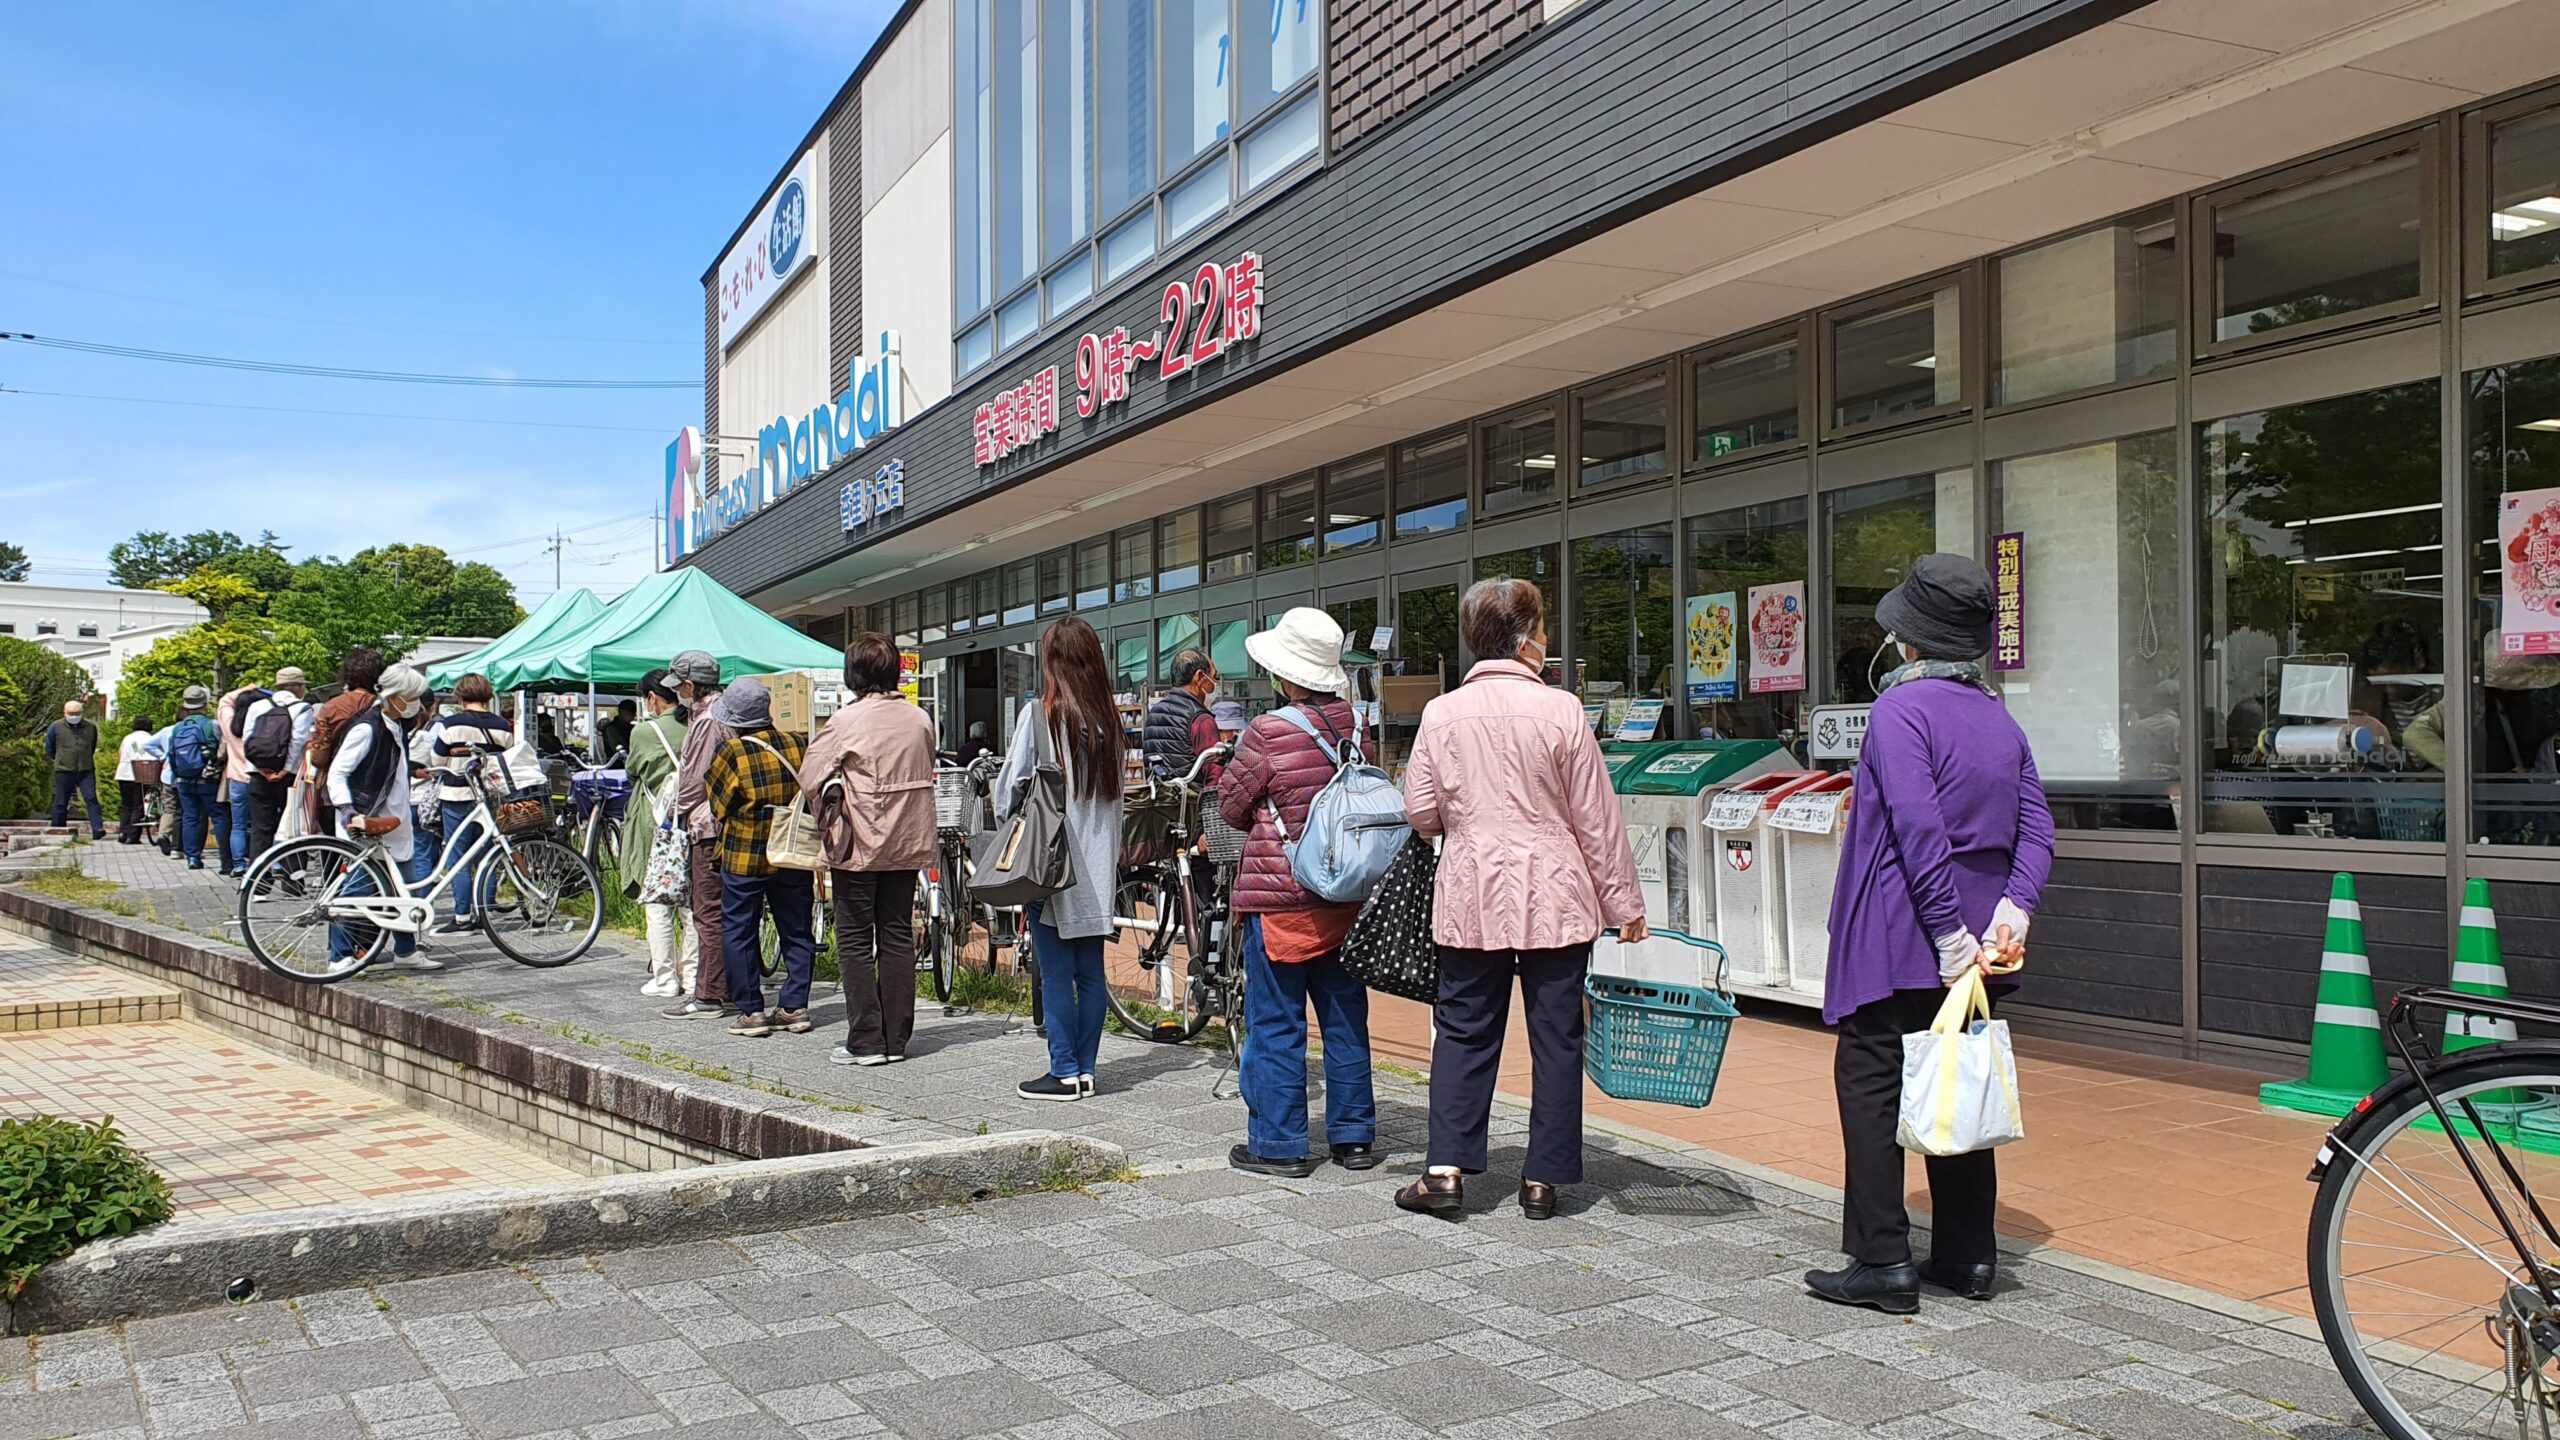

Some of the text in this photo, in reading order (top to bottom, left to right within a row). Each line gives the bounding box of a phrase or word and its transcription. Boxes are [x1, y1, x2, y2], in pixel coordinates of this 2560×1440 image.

[773, 189, 803, 265] 生活館
[758, 329, 900, 504] mandai
[973, 365, 1060, 469] 営業時間
[1997, 537, 2020, 666] 特別警戒実施中
